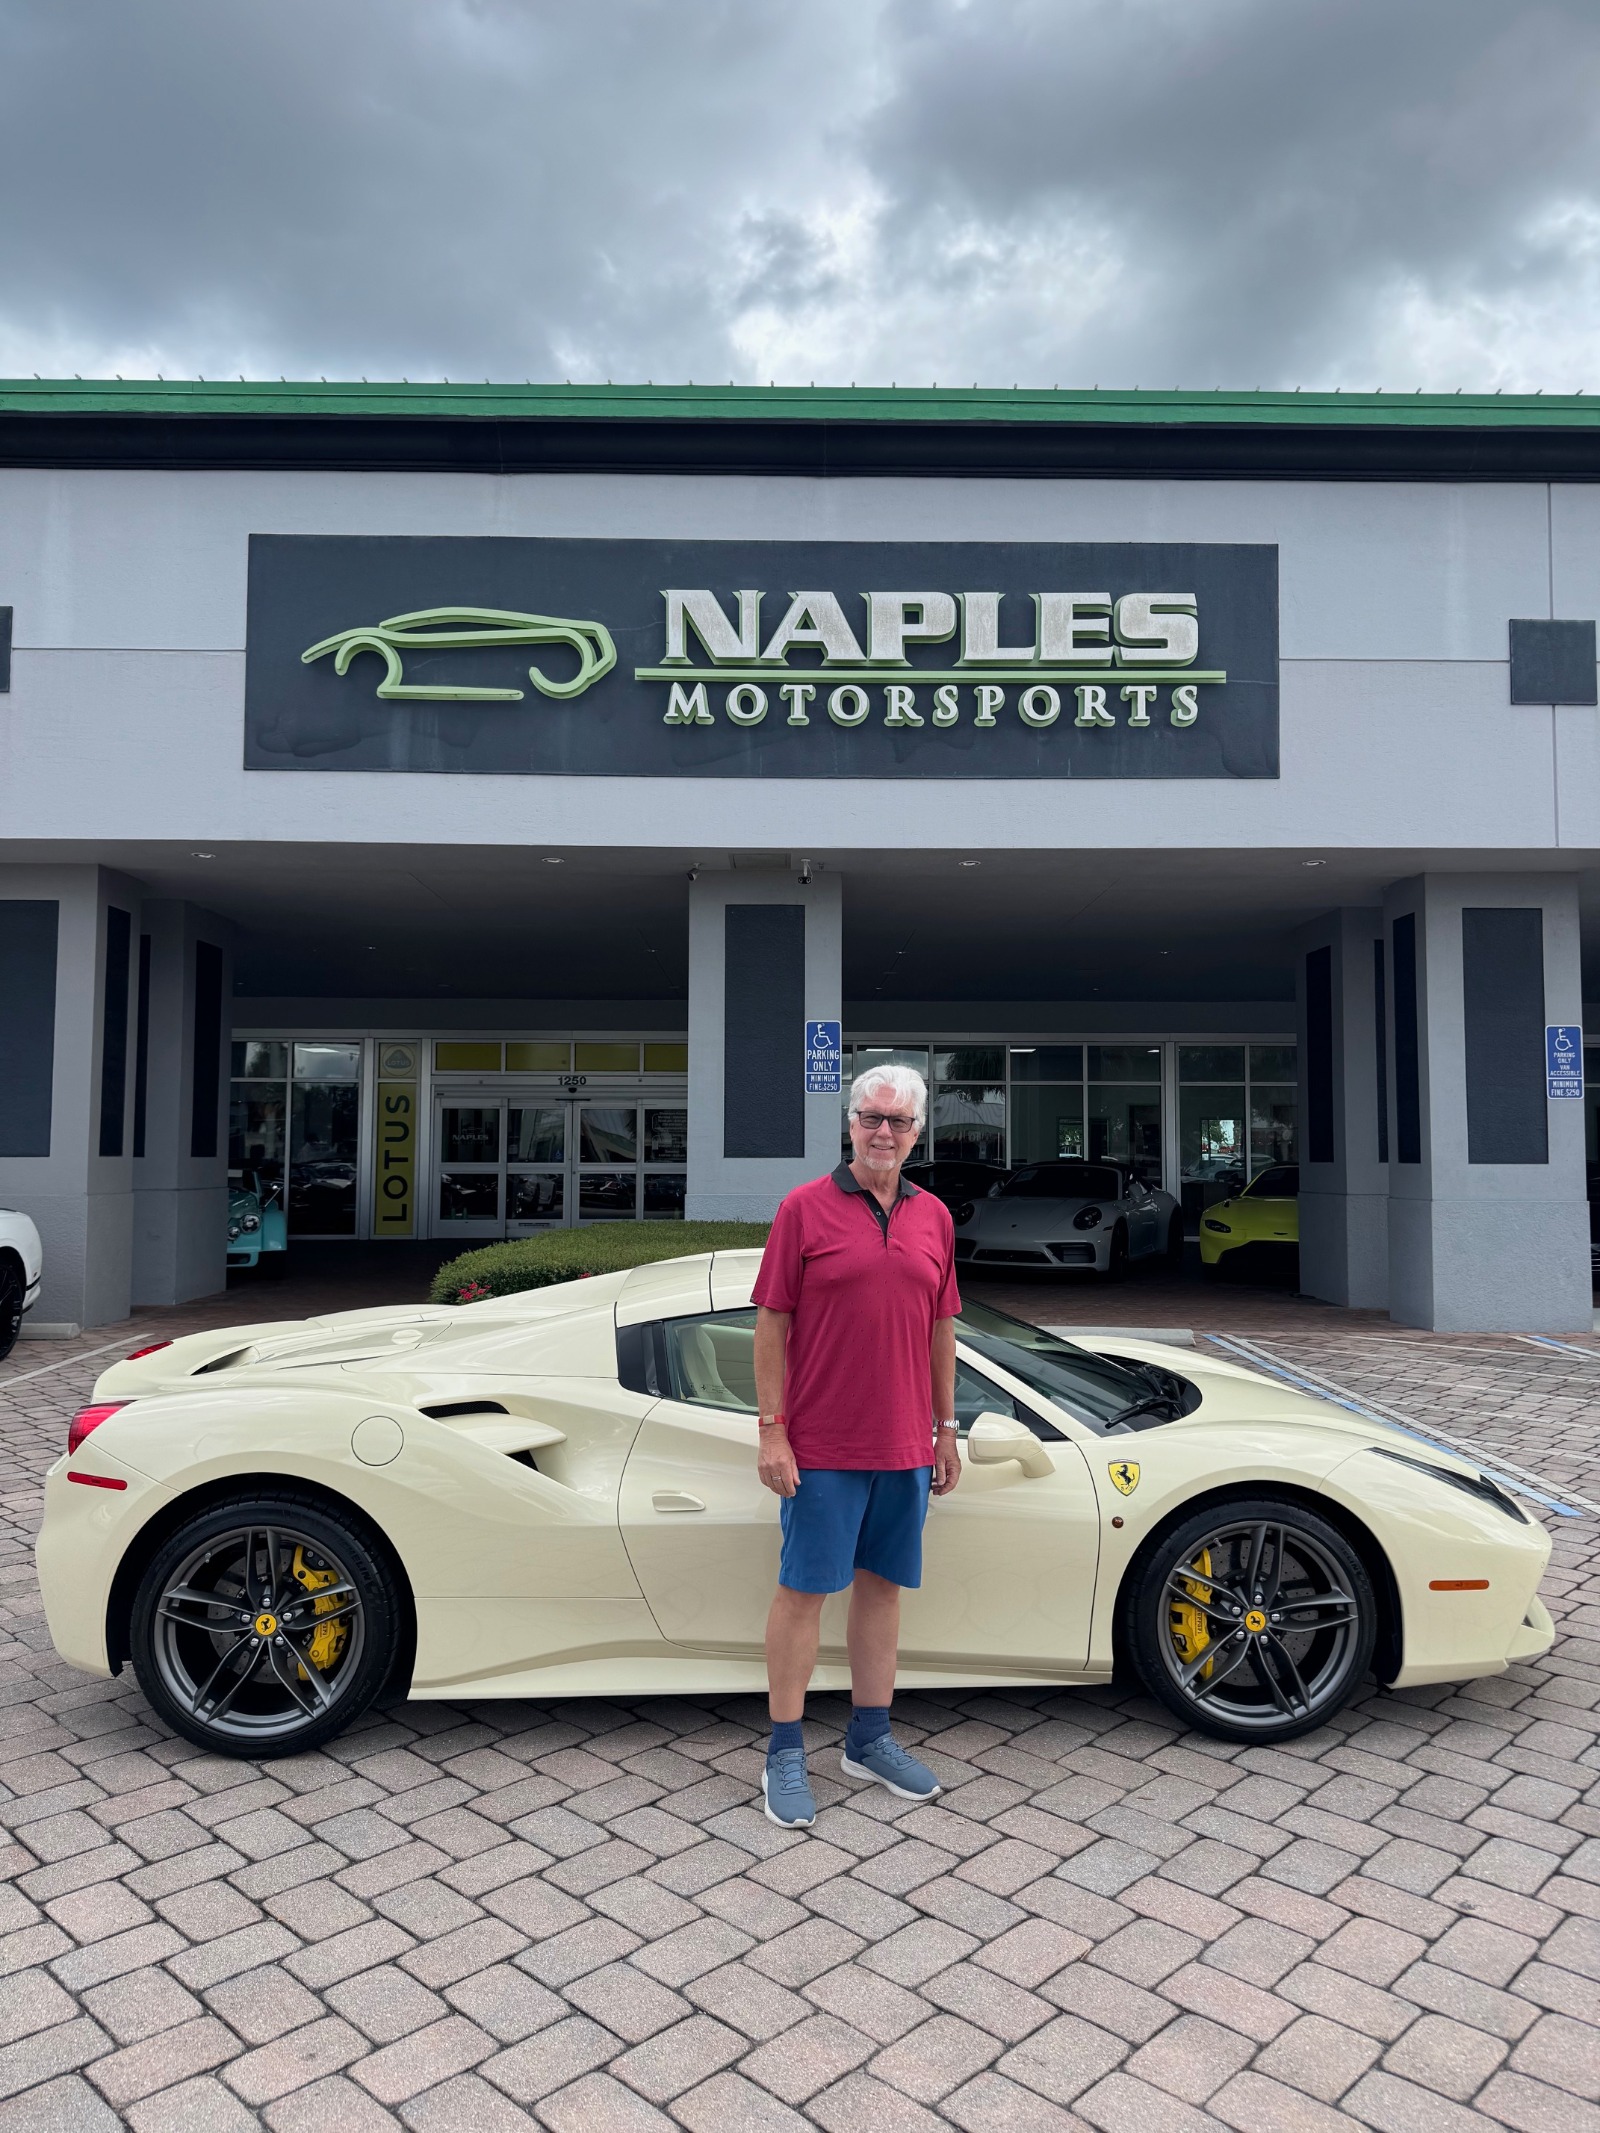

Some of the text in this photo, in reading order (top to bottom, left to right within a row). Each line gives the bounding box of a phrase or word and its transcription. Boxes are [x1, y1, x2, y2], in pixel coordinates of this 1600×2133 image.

[659, 589, 1199, 667] NAPLES
[663, 682, 1198, 727] MOTORSPORTS
[807, 1050, 840, 1060] PARKING
[813, 1061, 833, 1071] ONLY
[558, 1075, 587, 1086] 1250
[823, 1082, 838, 1091] $250
[382, 1094, 410, 1222] LOTUS
